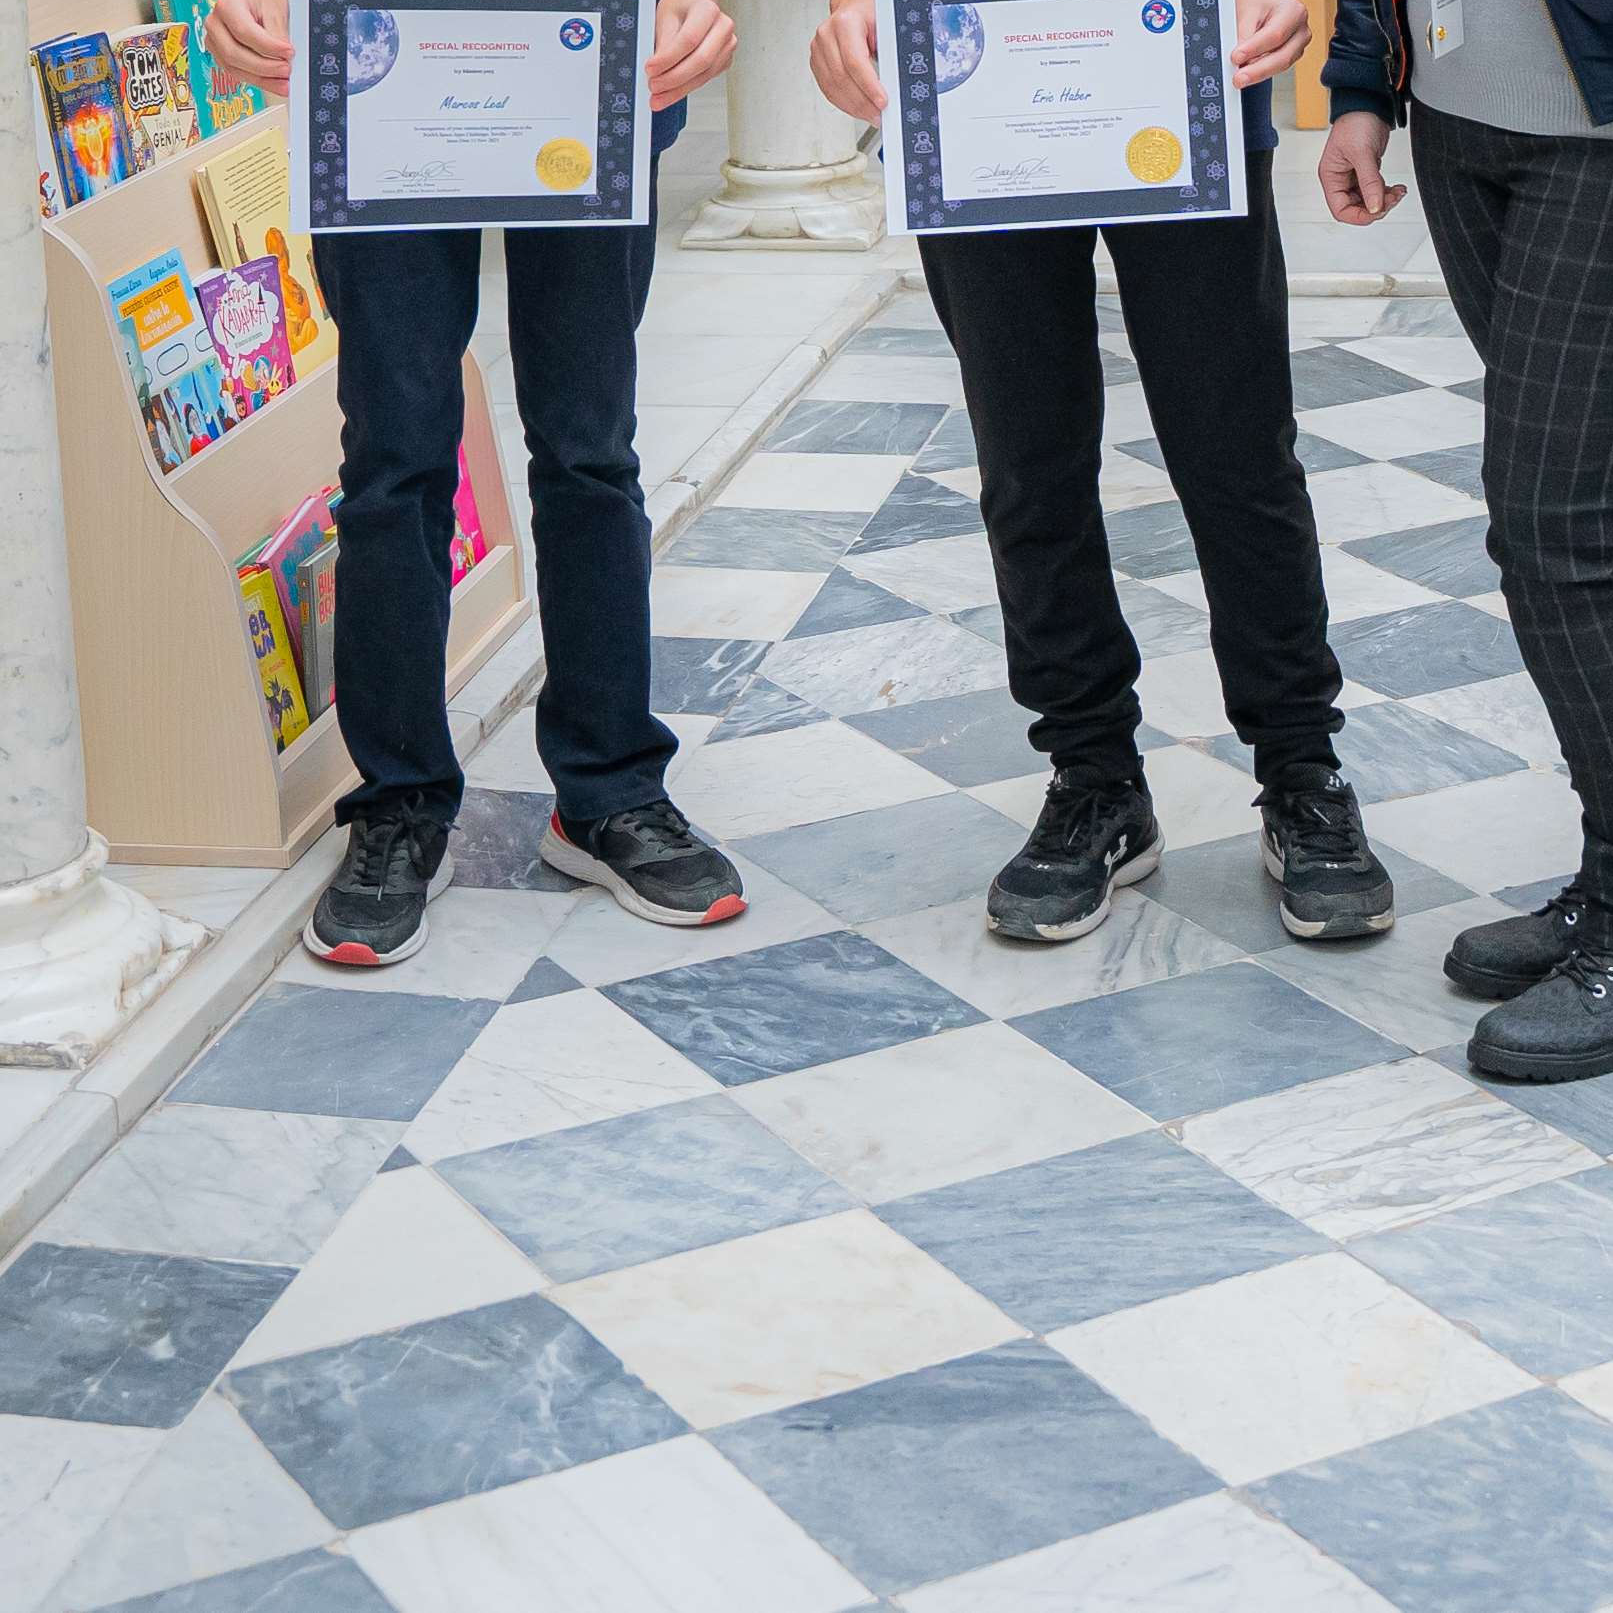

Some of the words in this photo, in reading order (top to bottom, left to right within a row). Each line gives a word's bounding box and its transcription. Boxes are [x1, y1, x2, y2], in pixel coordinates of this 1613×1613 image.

[1003, 33, 1044, 44] SPECIAL
[1045, 29, 1114, 41] RECOGNITION
[418, 42, 459, 52] SPECIAL
[461, 42, 531, 52] RECOGNITION
[126, 49, 160, 69] TOM
[129, 75, 164, 103] GATES
[1031, 88, 1054, 104] Eric
[1059, 87, 1092, 102] Haber
[439, 95, 480, 110] Marcos
[483, 95, 511, 110] Leal
[154, 118, 170, 128] Todo
[153, 132, 187, 148] GENIAL
[226, 284, 252, 306] Anna
